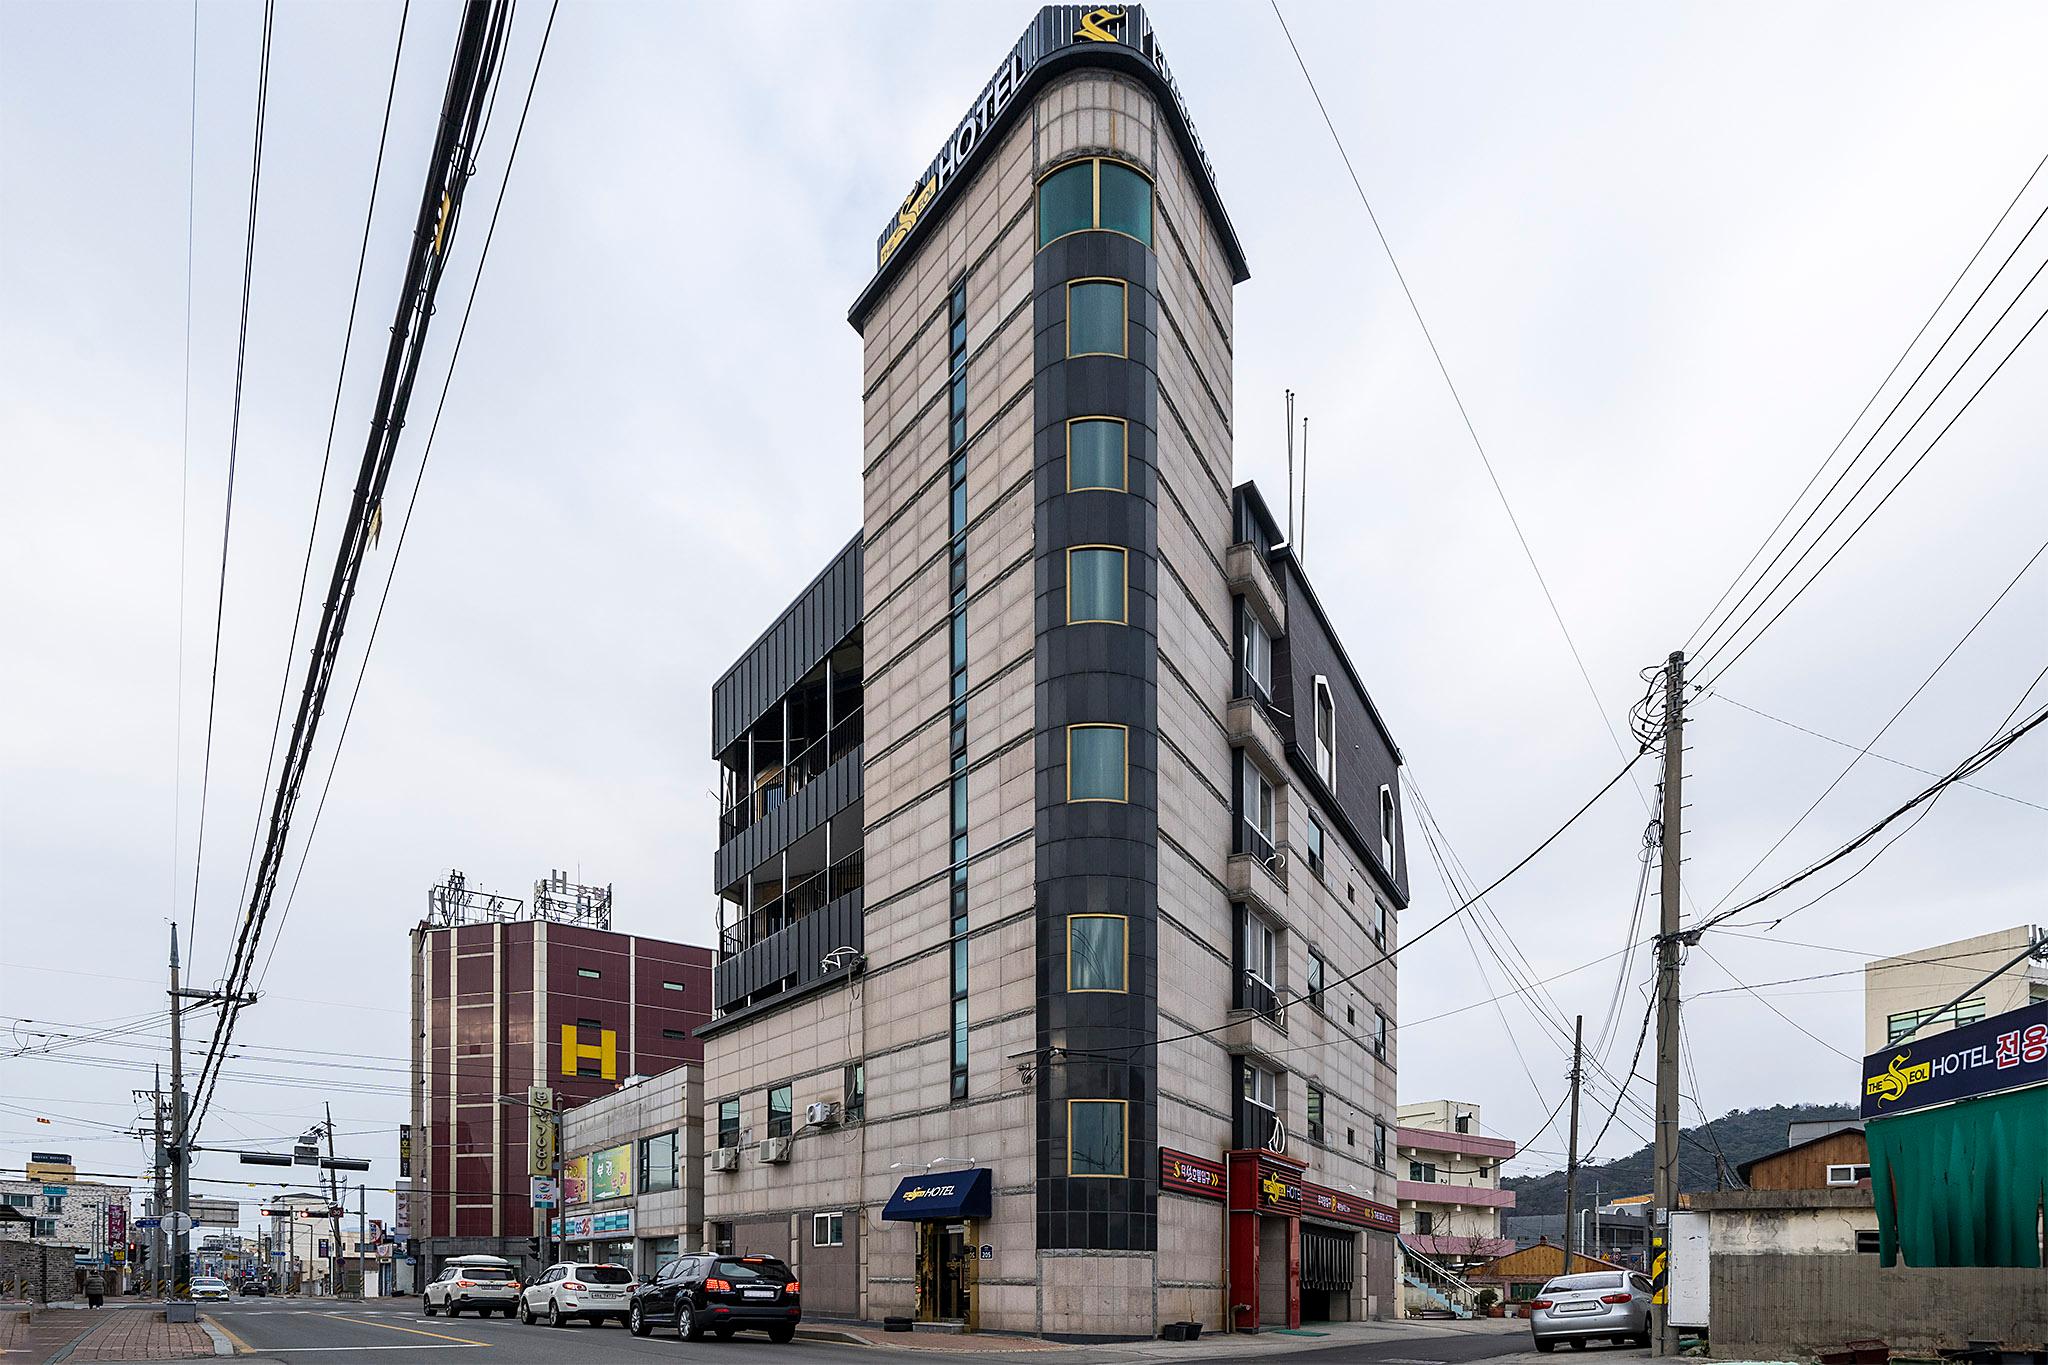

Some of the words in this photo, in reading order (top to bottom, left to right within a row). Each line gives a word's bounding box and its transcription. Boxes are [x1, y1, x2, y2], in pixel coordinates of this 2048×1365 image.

[938, 55, 1028, 191] HOTEL
[561, 1024, 617, 1080] H
[1868, 1081, 1883, 1092] THE
[1931, 1045, 1994, 1077] HOTEL
[1996, 1024, 2048, 1070] 전용
[924, 1185, 955, 1198] HOTEL
